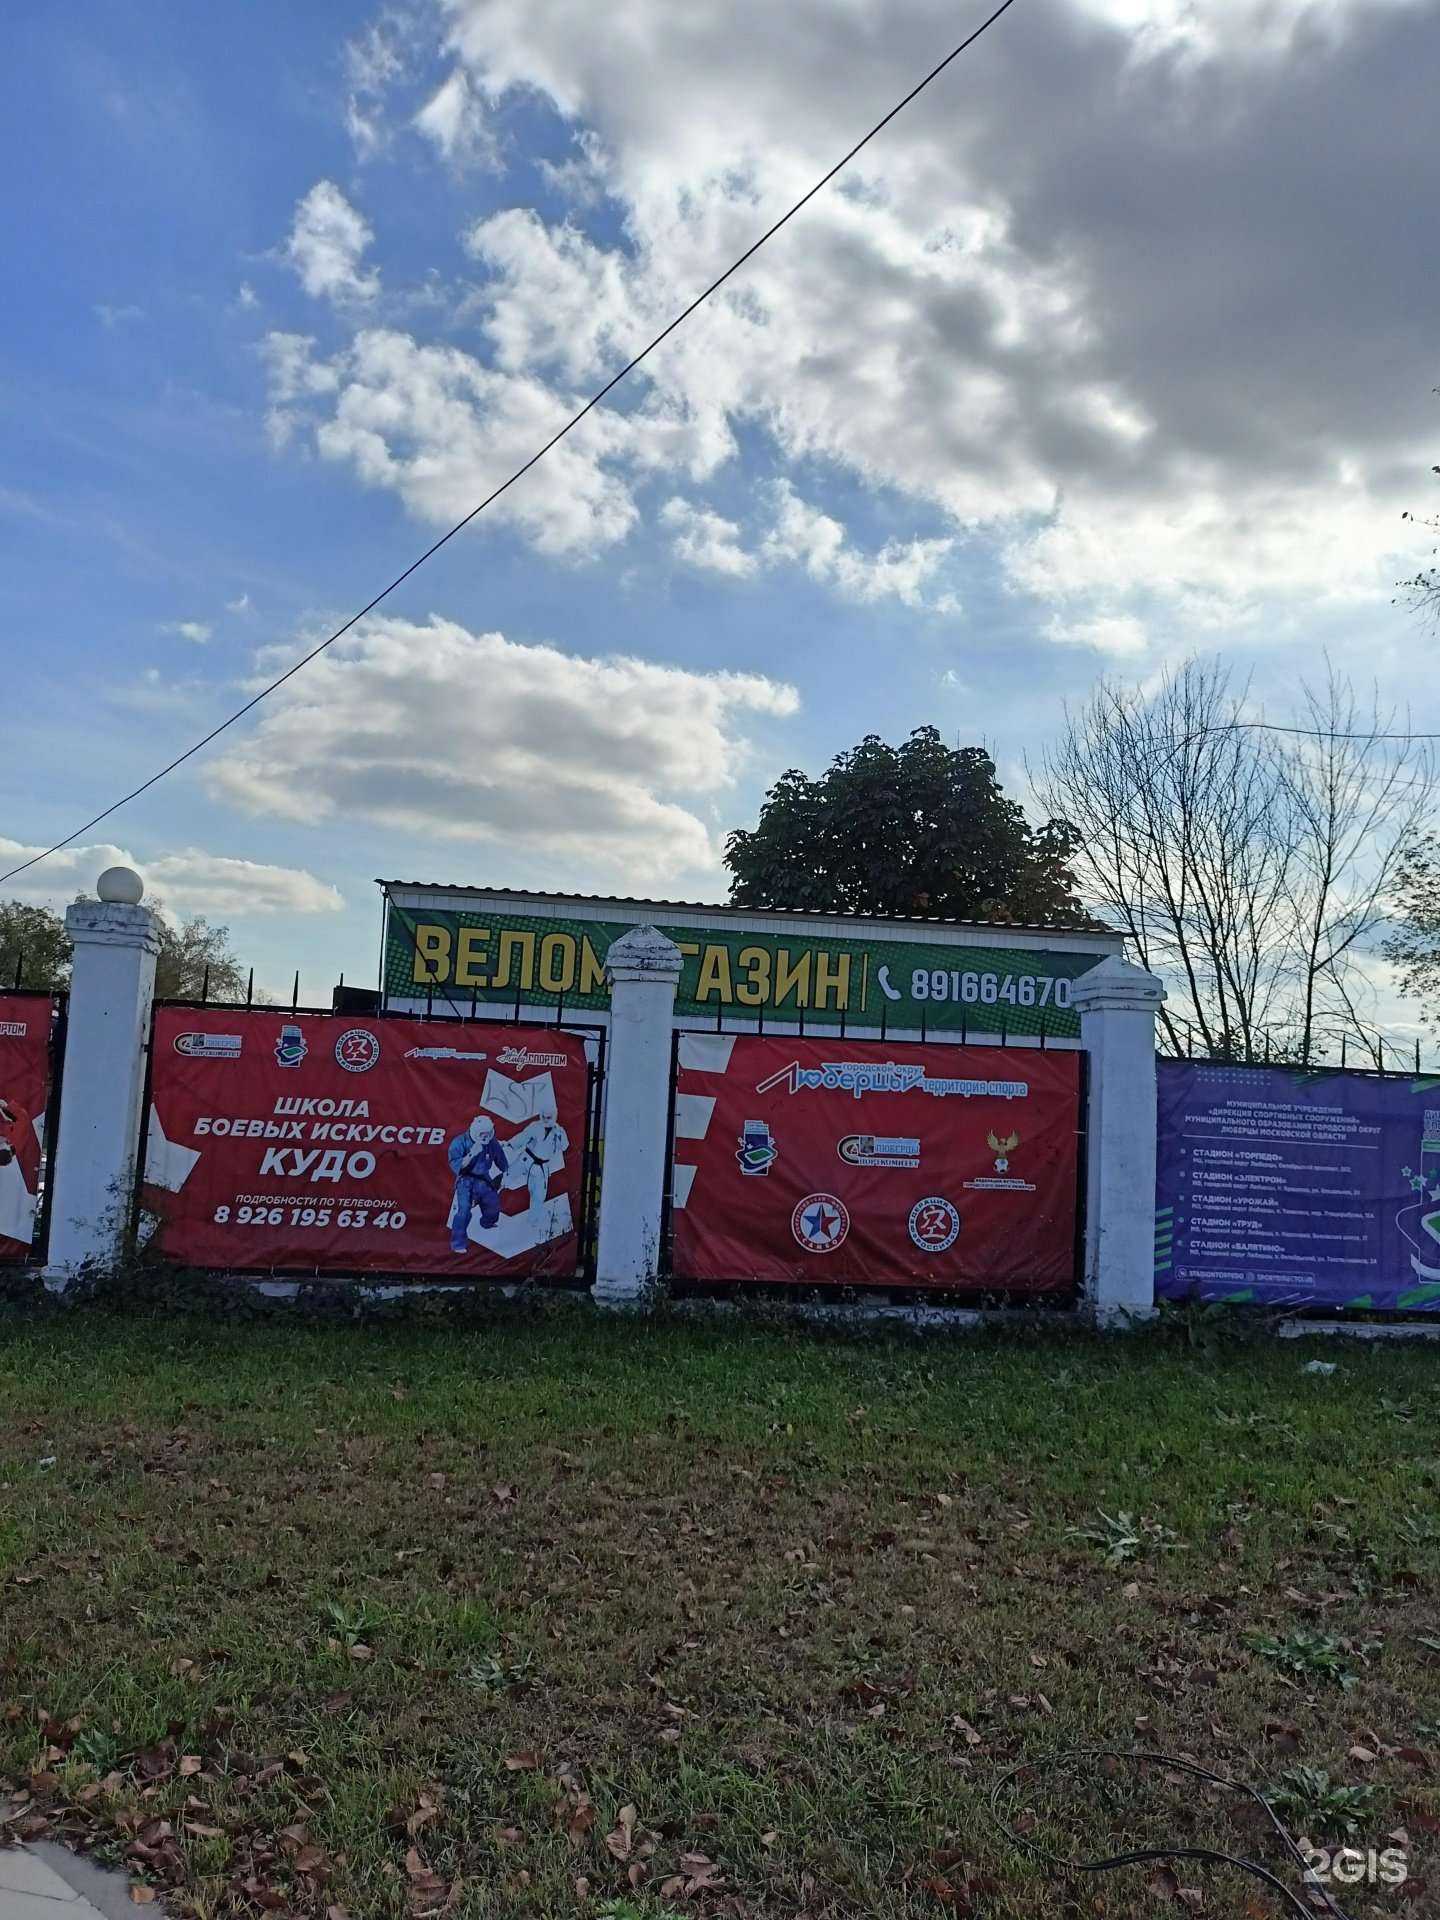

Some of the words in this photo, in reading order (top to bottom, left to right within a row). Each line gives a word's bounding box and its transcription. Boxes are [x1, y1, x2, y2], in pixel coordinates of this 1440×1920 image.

[0, 1022, 26, 1036] РТОМ
[923, 1078, 988, 1098] территория
[988, 1081, 1028, 1099] спорта
[273, 1096, 370, 1118] ШКОЛА
[194, 1117, 307, 1140] БОЕВЫХ
[311, 1122, 446, 1145] ИСКУССТВ
[1192, 1149, 1234, 1158] СТАДИОН
[259, 1147, 376, 1183] КУДО
[1192, 1172, 1234, 1181] СТАДИОН
[235, 1194, 317, 1206] ПОДРОБНОСТИ
[318, 1197, 335, 1206] ПО
[337, 1198, 398, 1209] ТЕЛЕФОНУ:
[1191, 1194, 1232, 1204] СТАДИОН
[214, 1206, 230, 1223] 8
[236, 1207, 284, 1226] 926
[289, 1209, 333, 1227] 195
[336, 1210, 369, 1228] 63
[373, 1211, 407, 1230] 40
[1190, 1217, 1231, 1227] СТАДИОН
[1190, 1240, 1231, 1249] СТАДИОН
